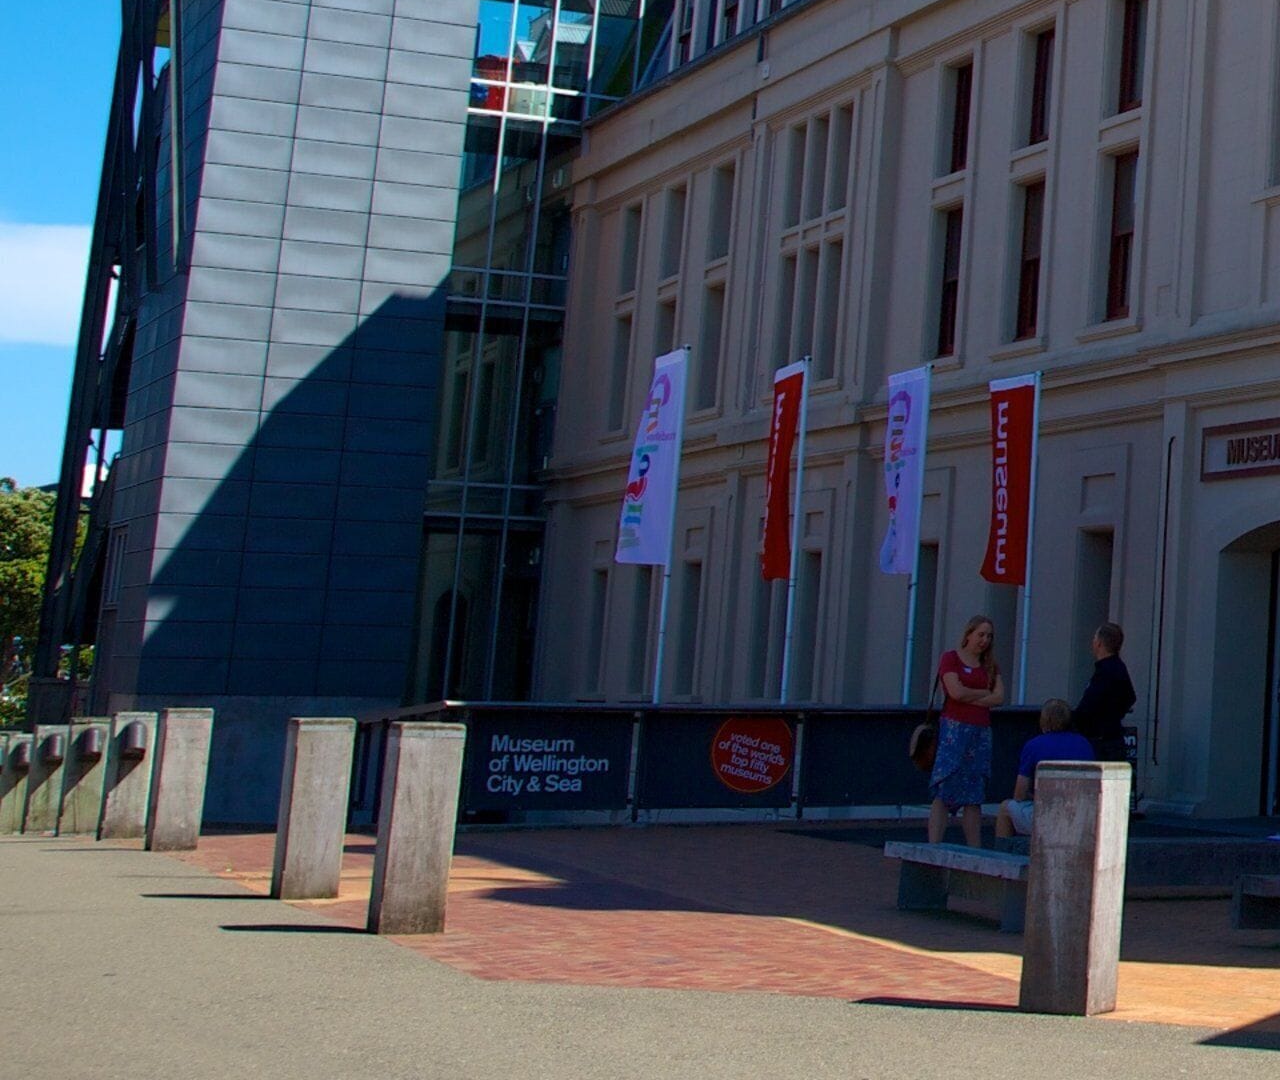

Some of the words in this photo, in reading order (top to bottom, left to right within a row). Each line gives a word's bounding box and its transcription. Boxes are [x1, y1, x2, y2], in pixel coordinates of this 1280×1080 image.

[491, 734, 575, 752] Museum
[719, 740, 731, 750] of
[731, 742, 748, 755] the
[731, 733, 760, 747] voted
[761, 741, 780, 753] one
[489, 754, 510, 772] of
[513, 754, 609, 775] Wellington
[731, 754, 749, 767] top
[750, 758, 769, 774] fifty
[720, 764, 772, 785] museums
[486, 774, 524, 796] City
[526, 775, 541, 792] &
[544, 774, 582, 792] Sea
